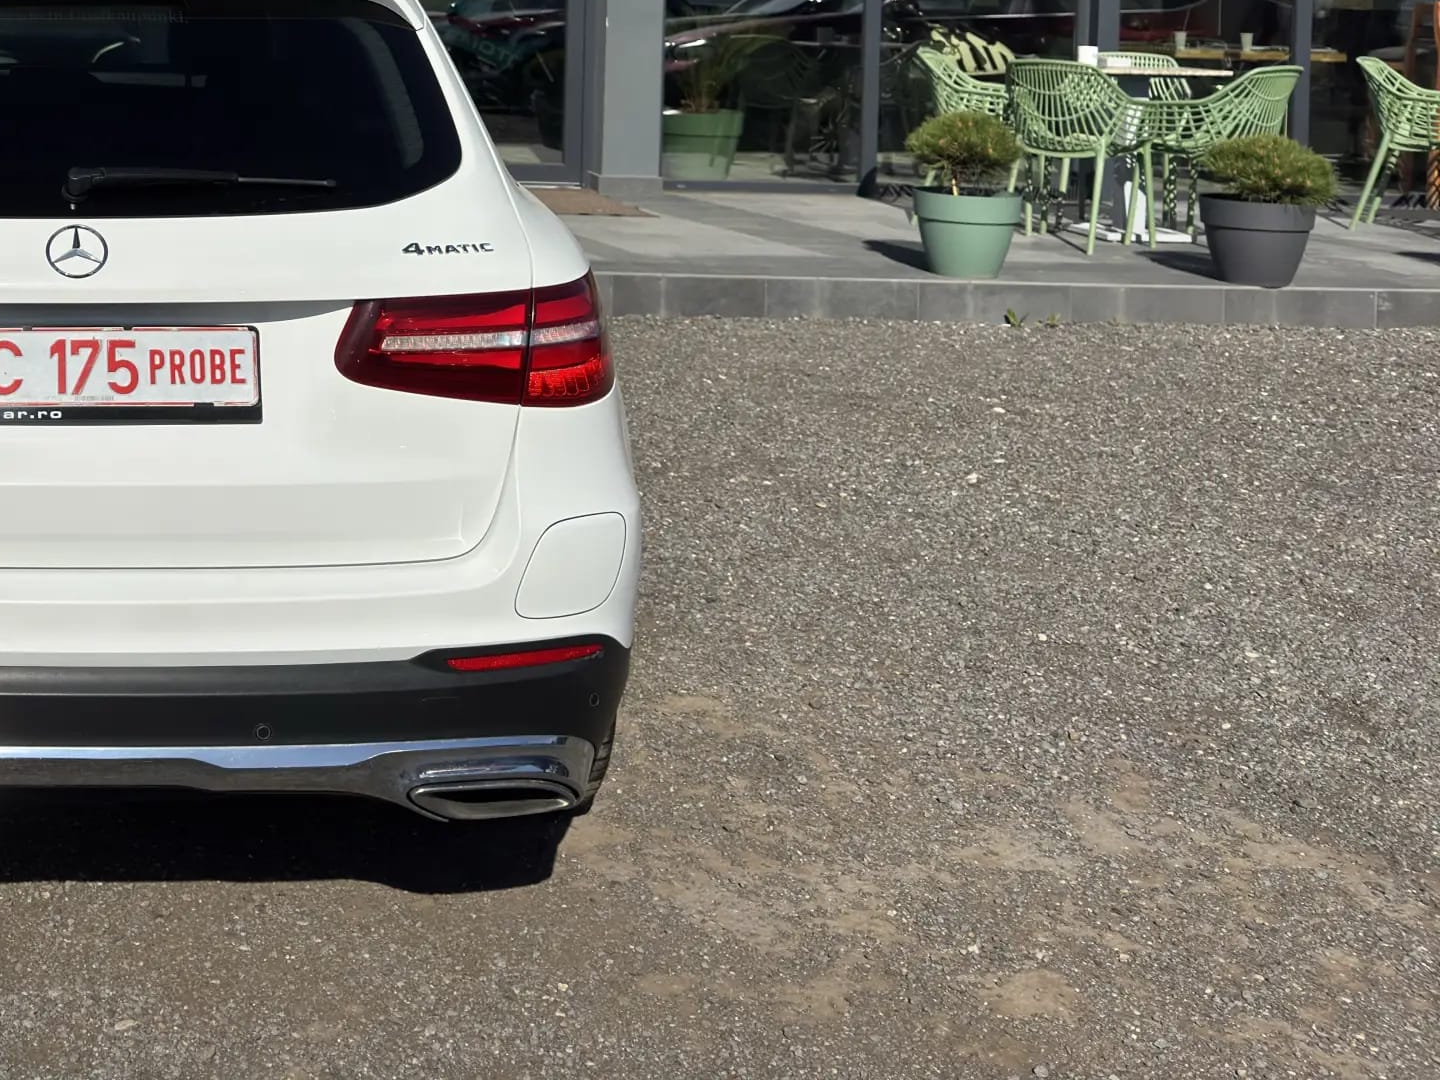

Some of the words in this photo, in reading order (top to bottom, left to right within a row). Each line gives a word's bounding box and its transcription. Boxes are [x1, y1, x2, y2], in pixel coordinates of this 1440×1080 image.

[401, 242, 495, 256] 4MATIC
[49, 338, 140, 395] 175
[149, 348, 247, 385] PROBE
